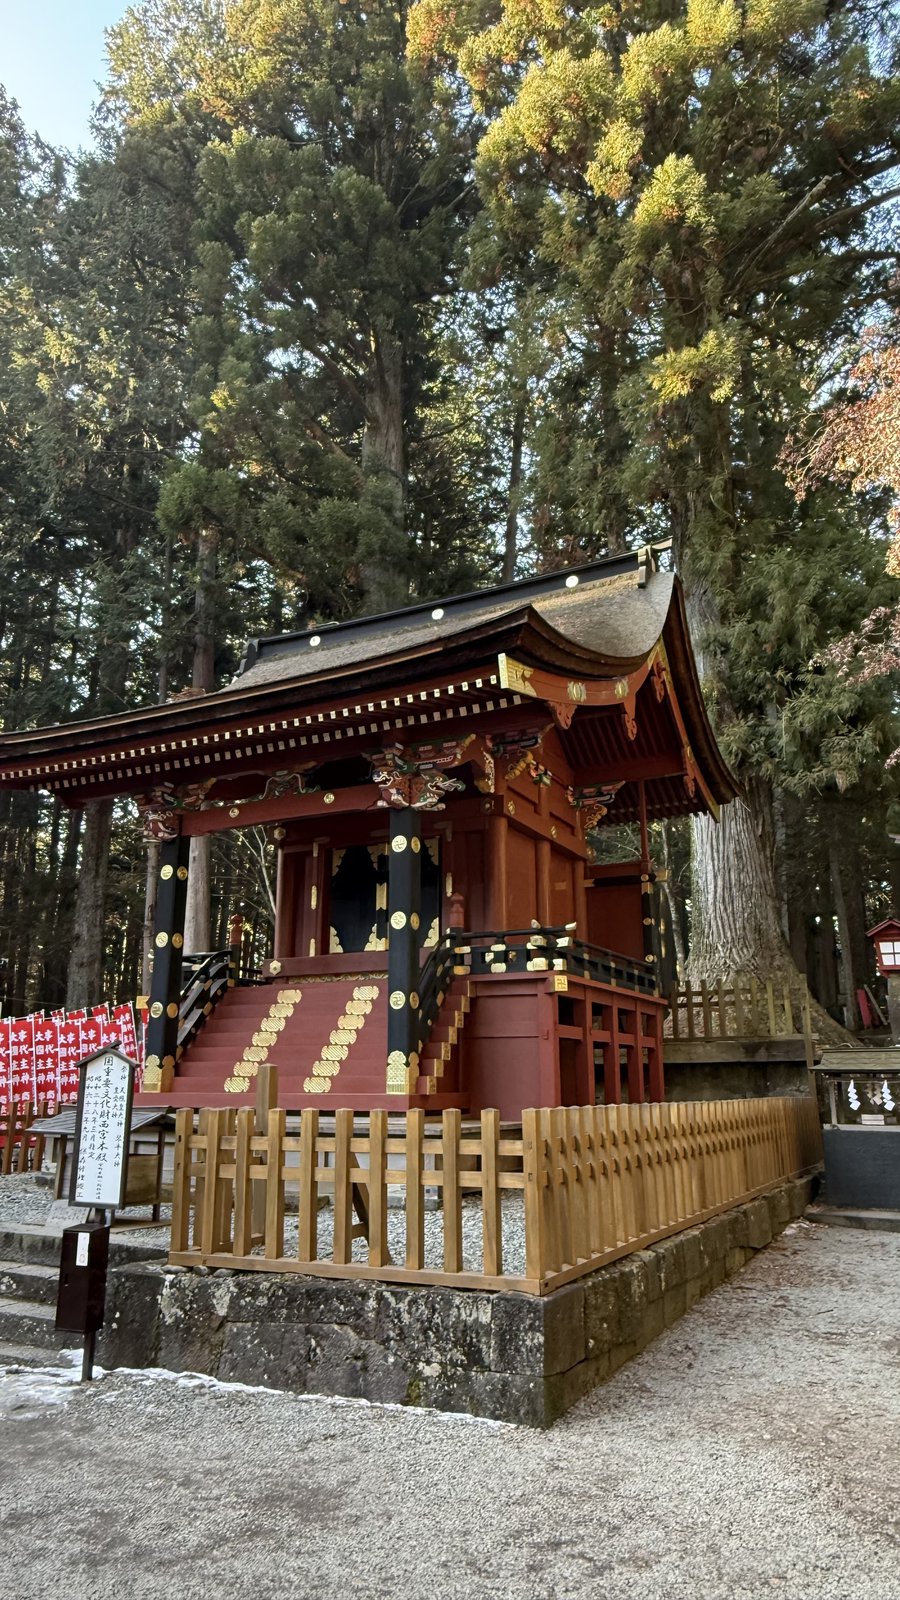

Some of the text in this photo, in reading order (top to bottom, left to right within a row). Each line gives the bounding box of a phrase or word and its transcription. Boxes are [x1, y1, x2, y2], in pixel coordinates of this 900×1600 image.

[18, 1029, 30, 1085] 事代主神
[35, 1031, 46, 1085] 大国主神
[44, 1029, 55, 1082] 事代主神
[59, 1034, 69, 1087] 大国主神
[67, 1031, 77, 1086] 事代主神
